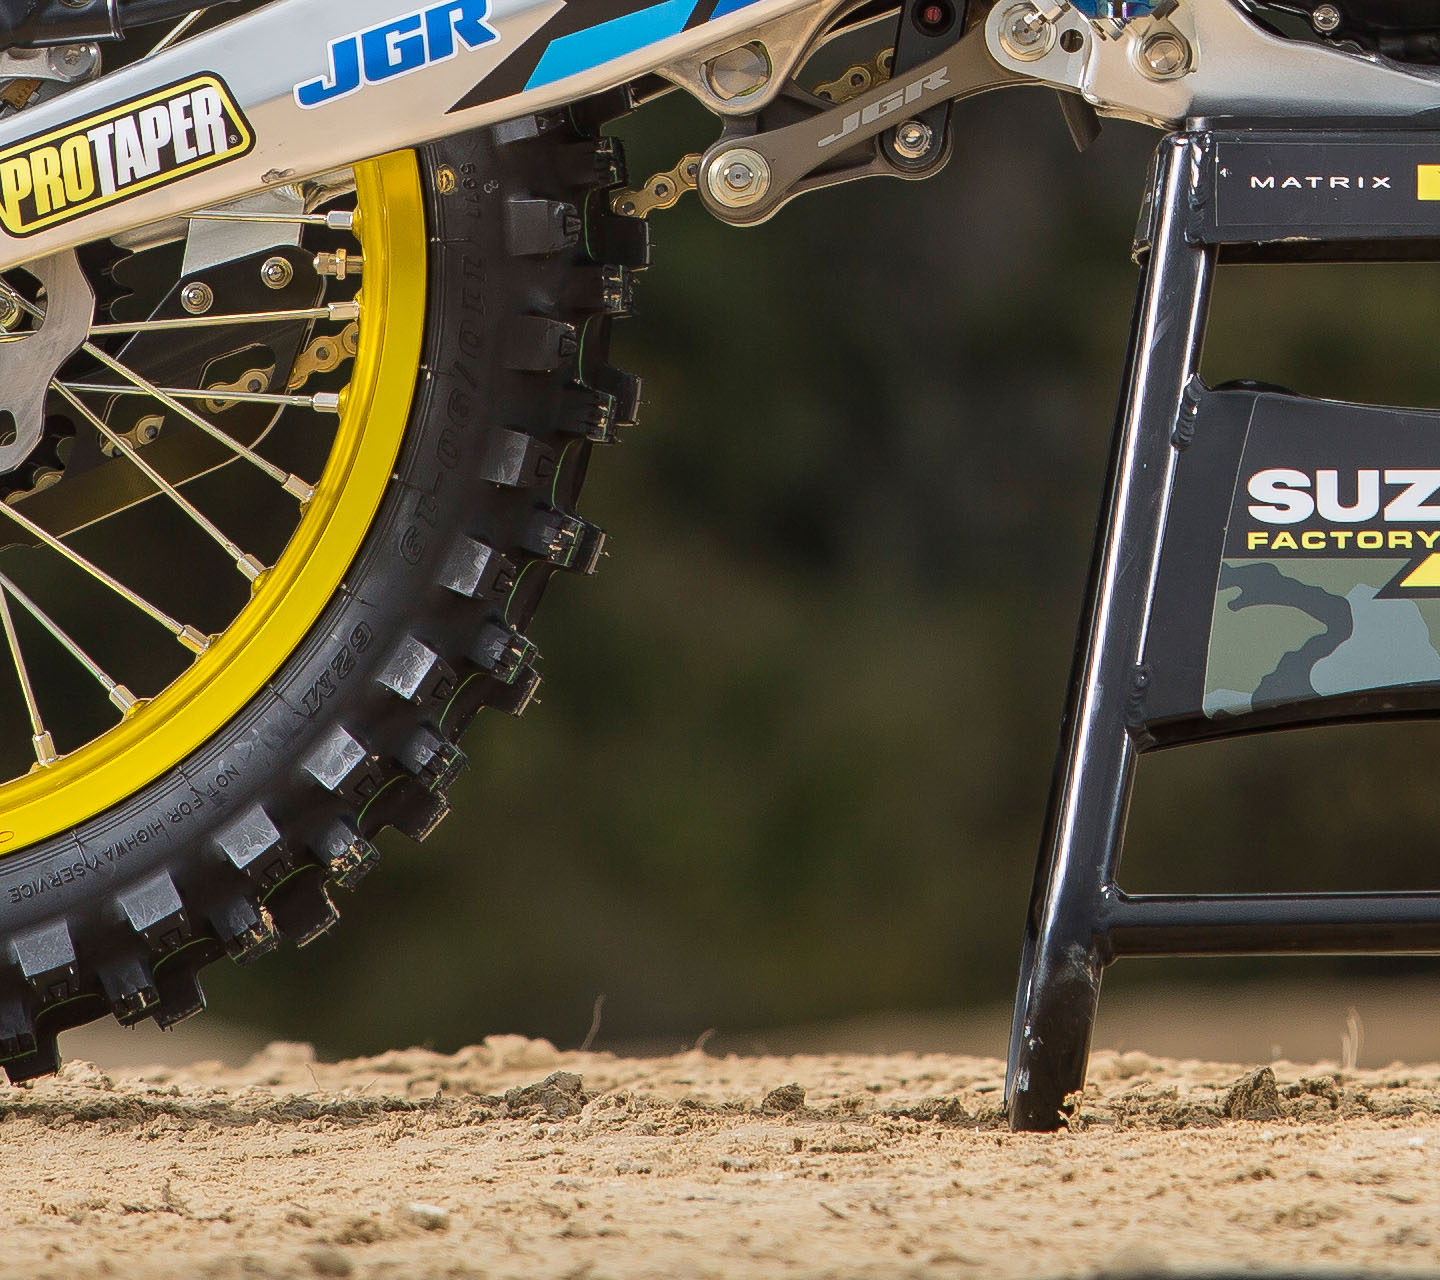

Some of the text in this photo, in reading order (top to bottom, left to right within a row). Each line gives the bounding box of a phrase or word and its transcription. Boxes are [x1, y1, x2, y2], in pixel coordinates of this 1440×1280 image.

[817, 65, 952, 148] JGR
[1250, 174, 1392, 191] MATRIX
[8, 763, 239, 903] NOT FOR HIGHWAY SERVICE
